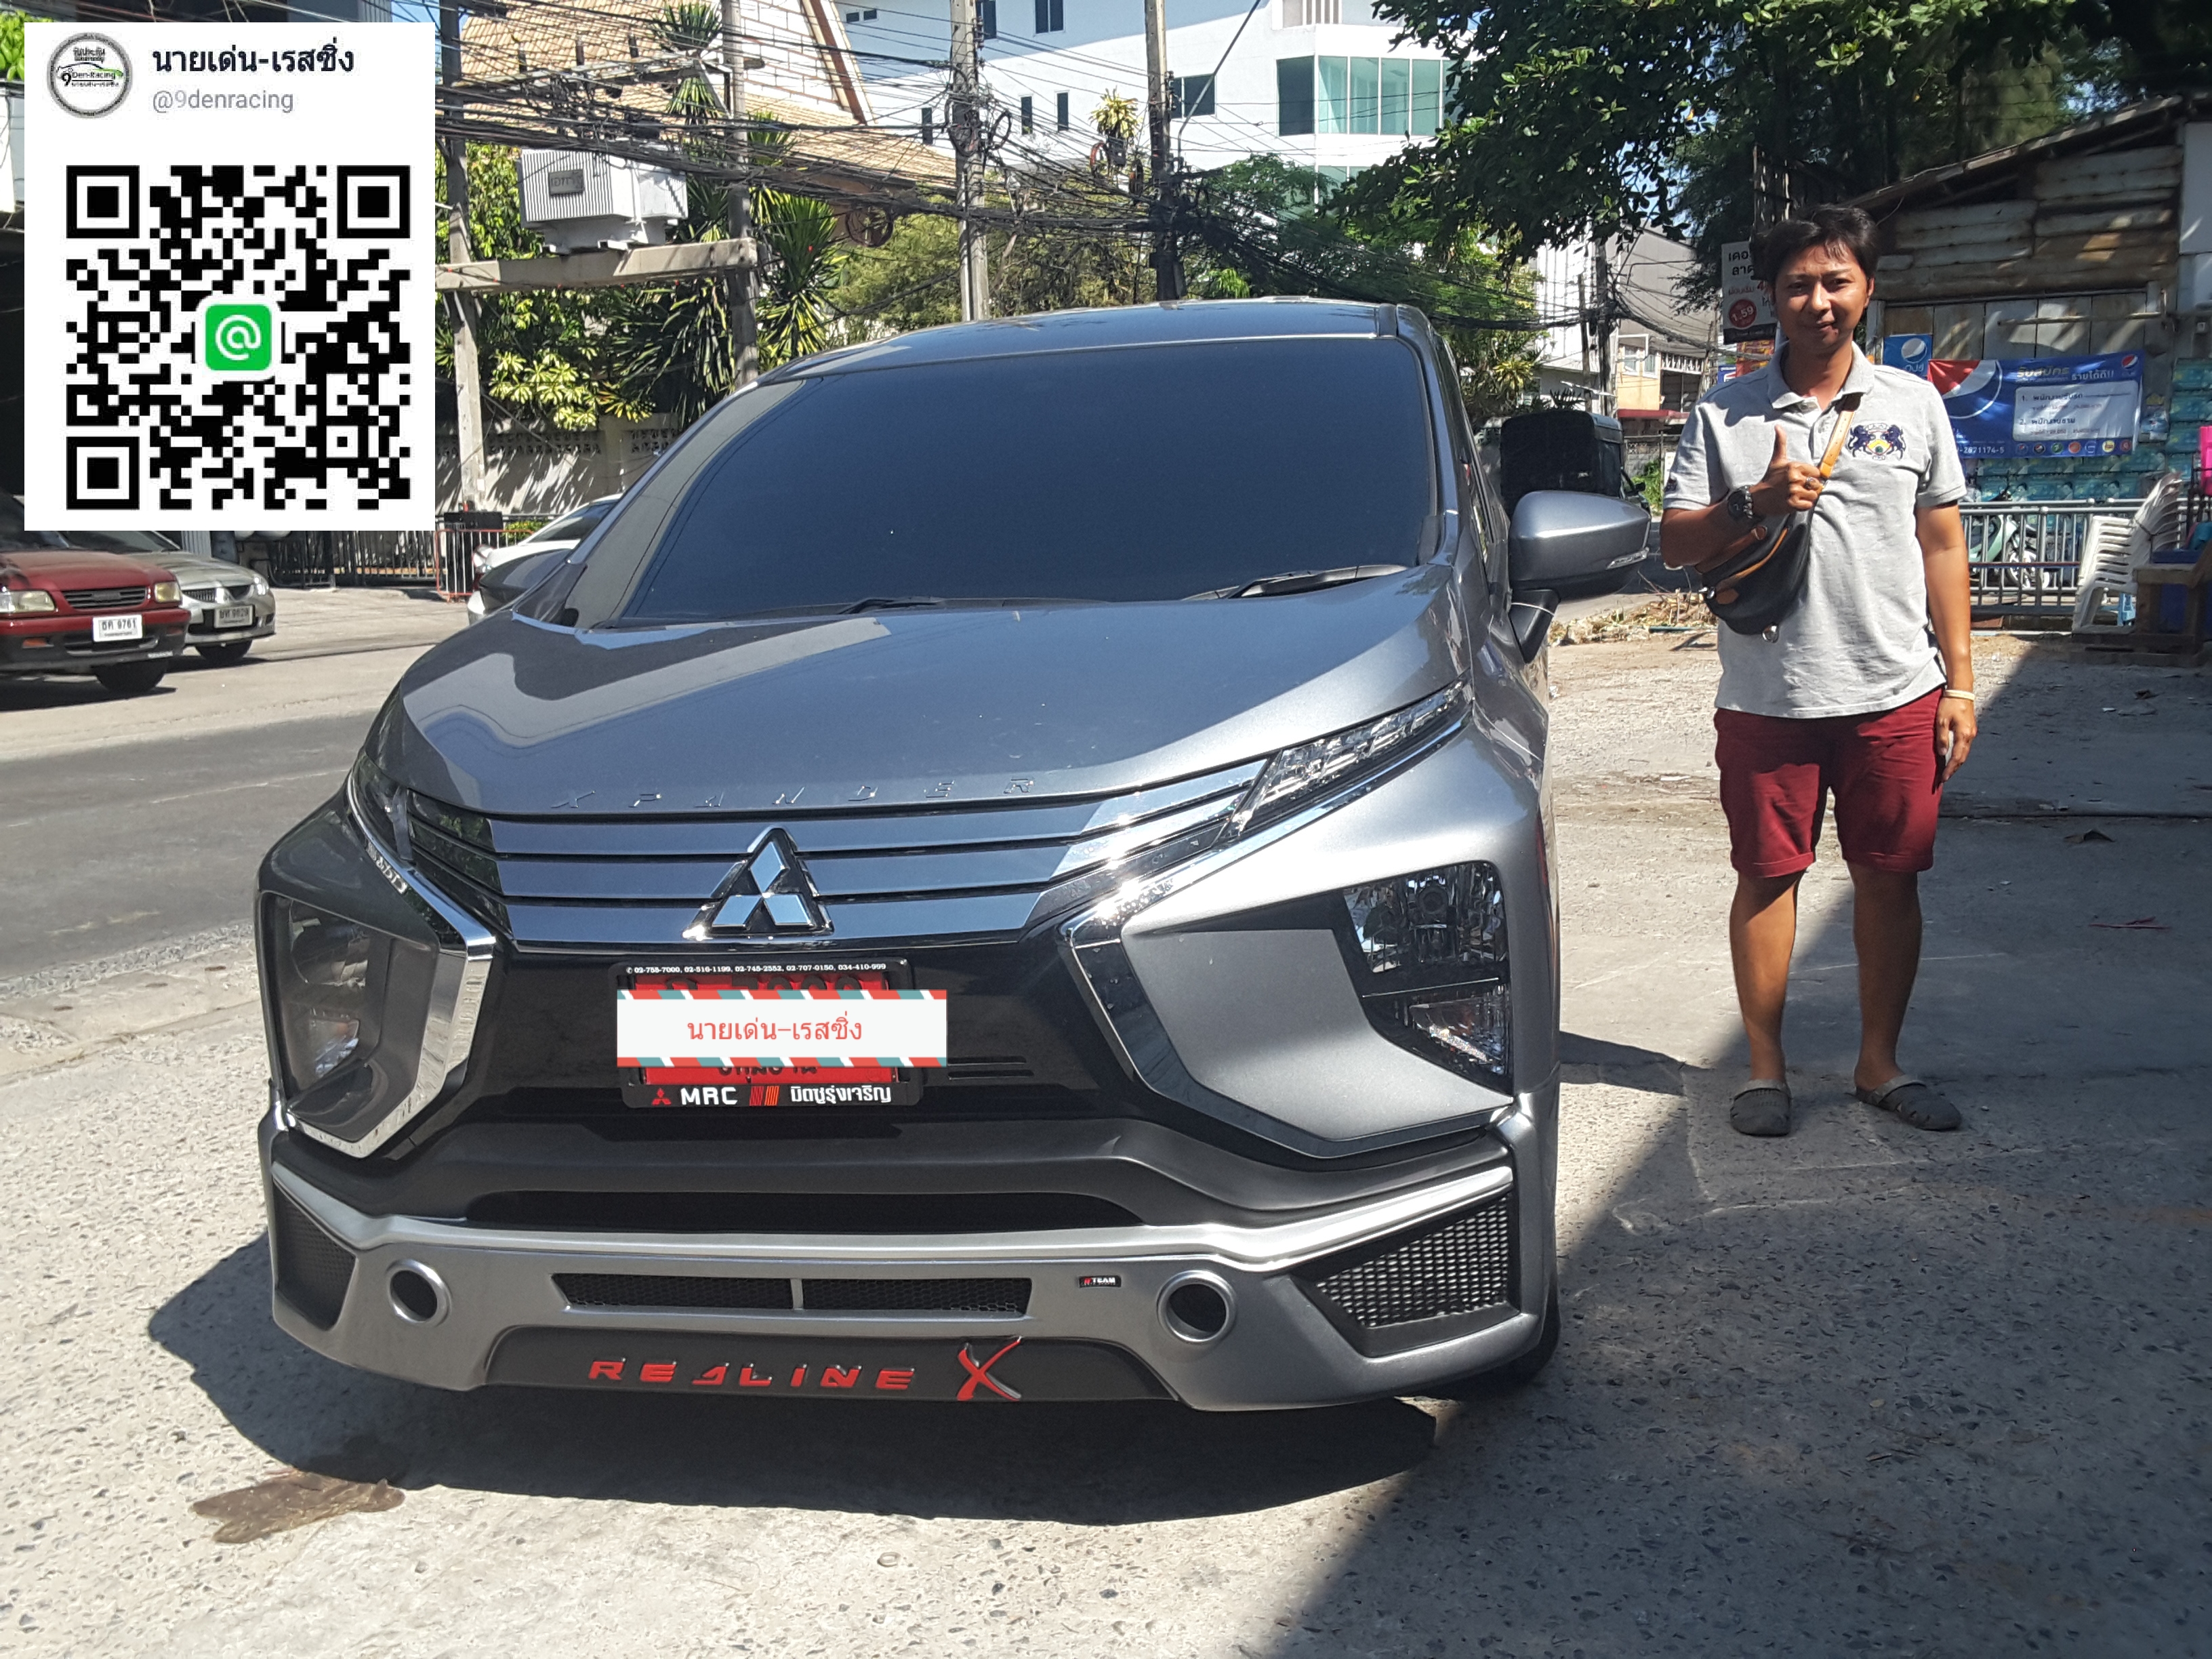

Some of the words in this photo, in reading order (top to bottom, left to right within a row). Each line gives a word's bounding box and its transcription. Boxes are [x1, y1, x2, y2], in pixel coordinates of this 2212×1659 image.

[680, 1087, 738, 1105] MRC
[588, 1358, 915, 1390] REALINE
[957, 1336, 1021, 1401] X
